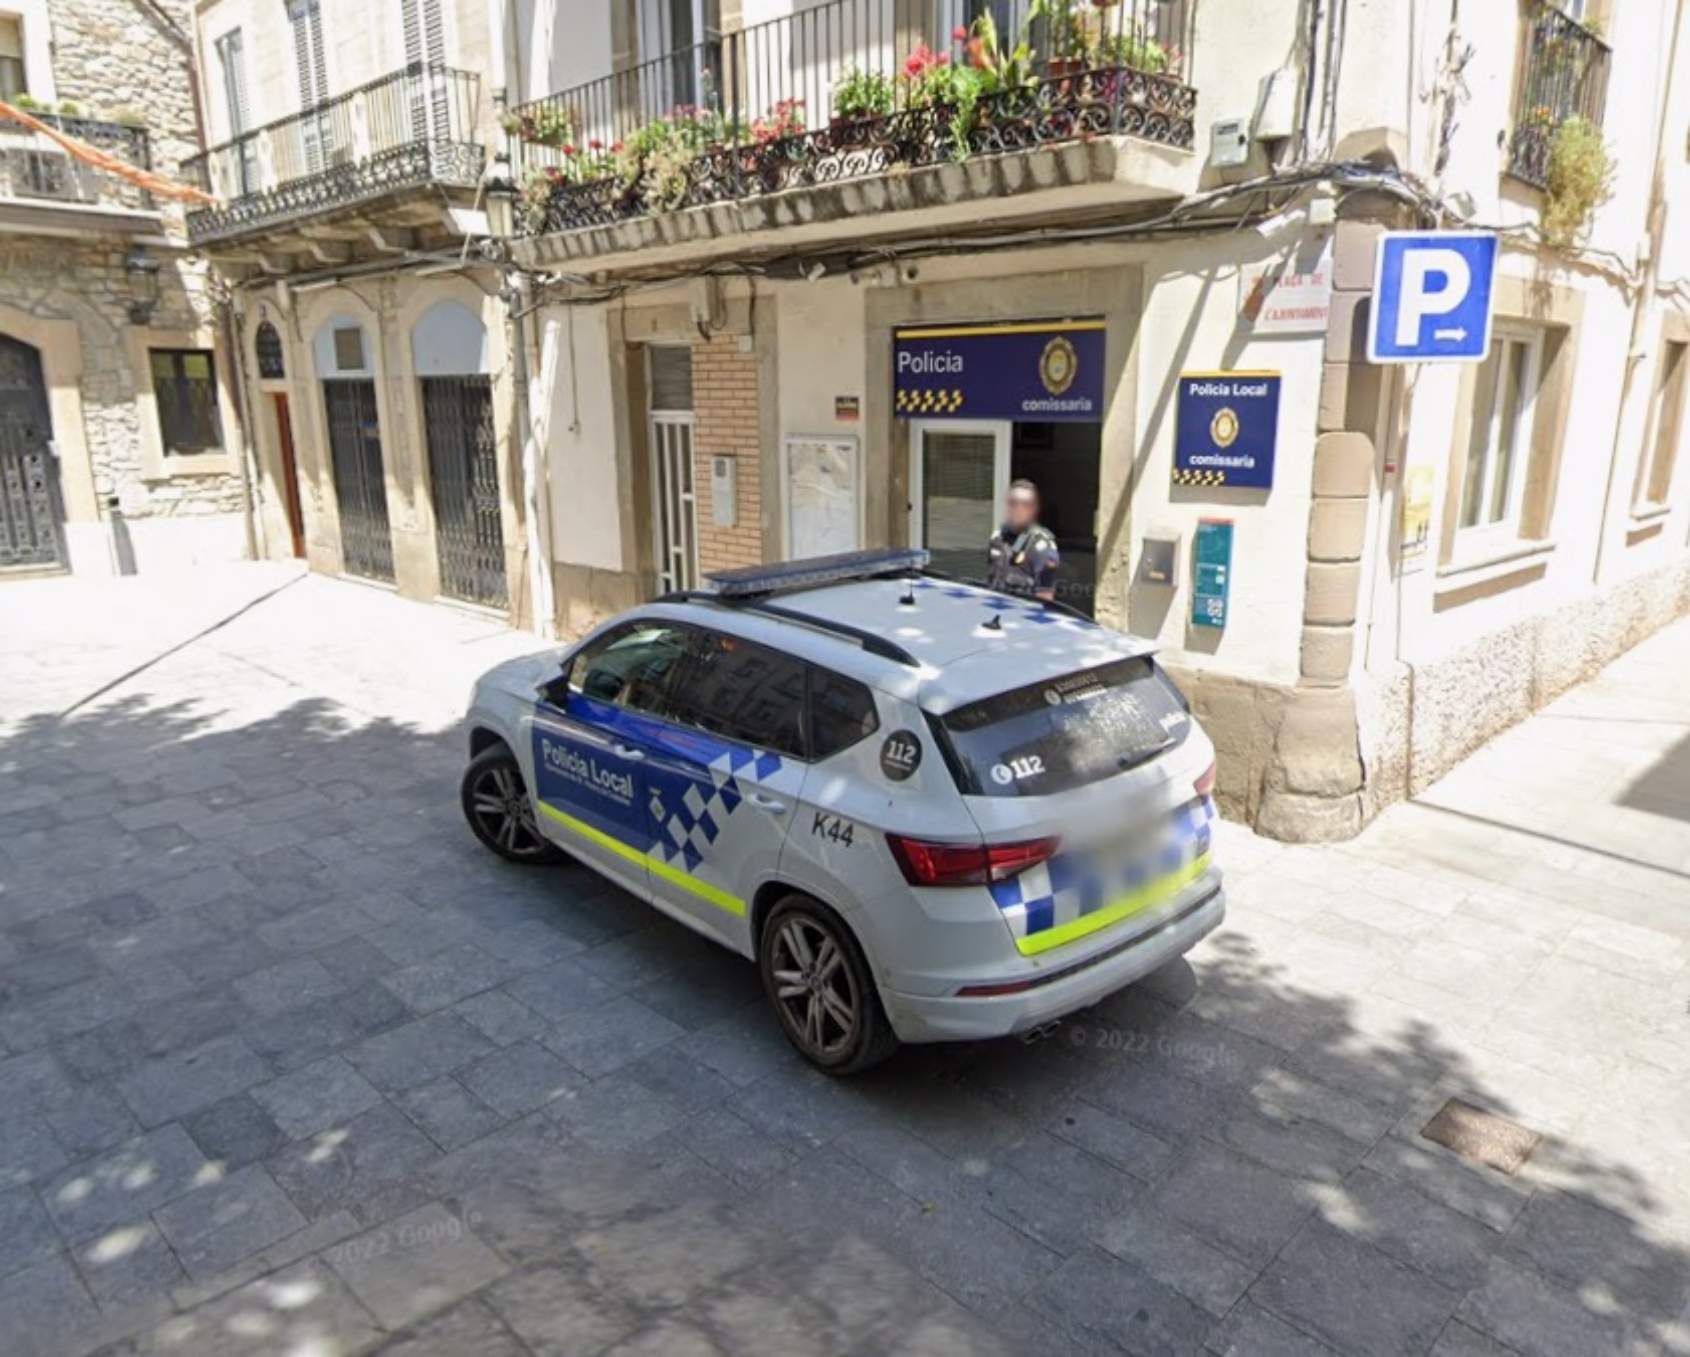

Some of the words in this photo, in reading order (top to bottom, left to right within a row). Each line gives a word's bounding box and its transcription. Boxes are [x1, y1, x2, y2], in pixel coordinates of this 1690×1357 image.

[1395, 249, 1470, 346] P
[898, 351, 964, 373] Policia
[1189, 383, 1230, 396] Policia
[1232, 383, 1268, 396] Local
[1022, 398, 1092, 412] comissaria
[1189, 454, 1255, 469] comissaria
[886, 741, 916, 764] 112
[542, 739, 589, 778] Policia
[590, 759, 634, 799] Local
[1011, 755, 1045, 779] 112
[812, 812, 854, 847] K44
